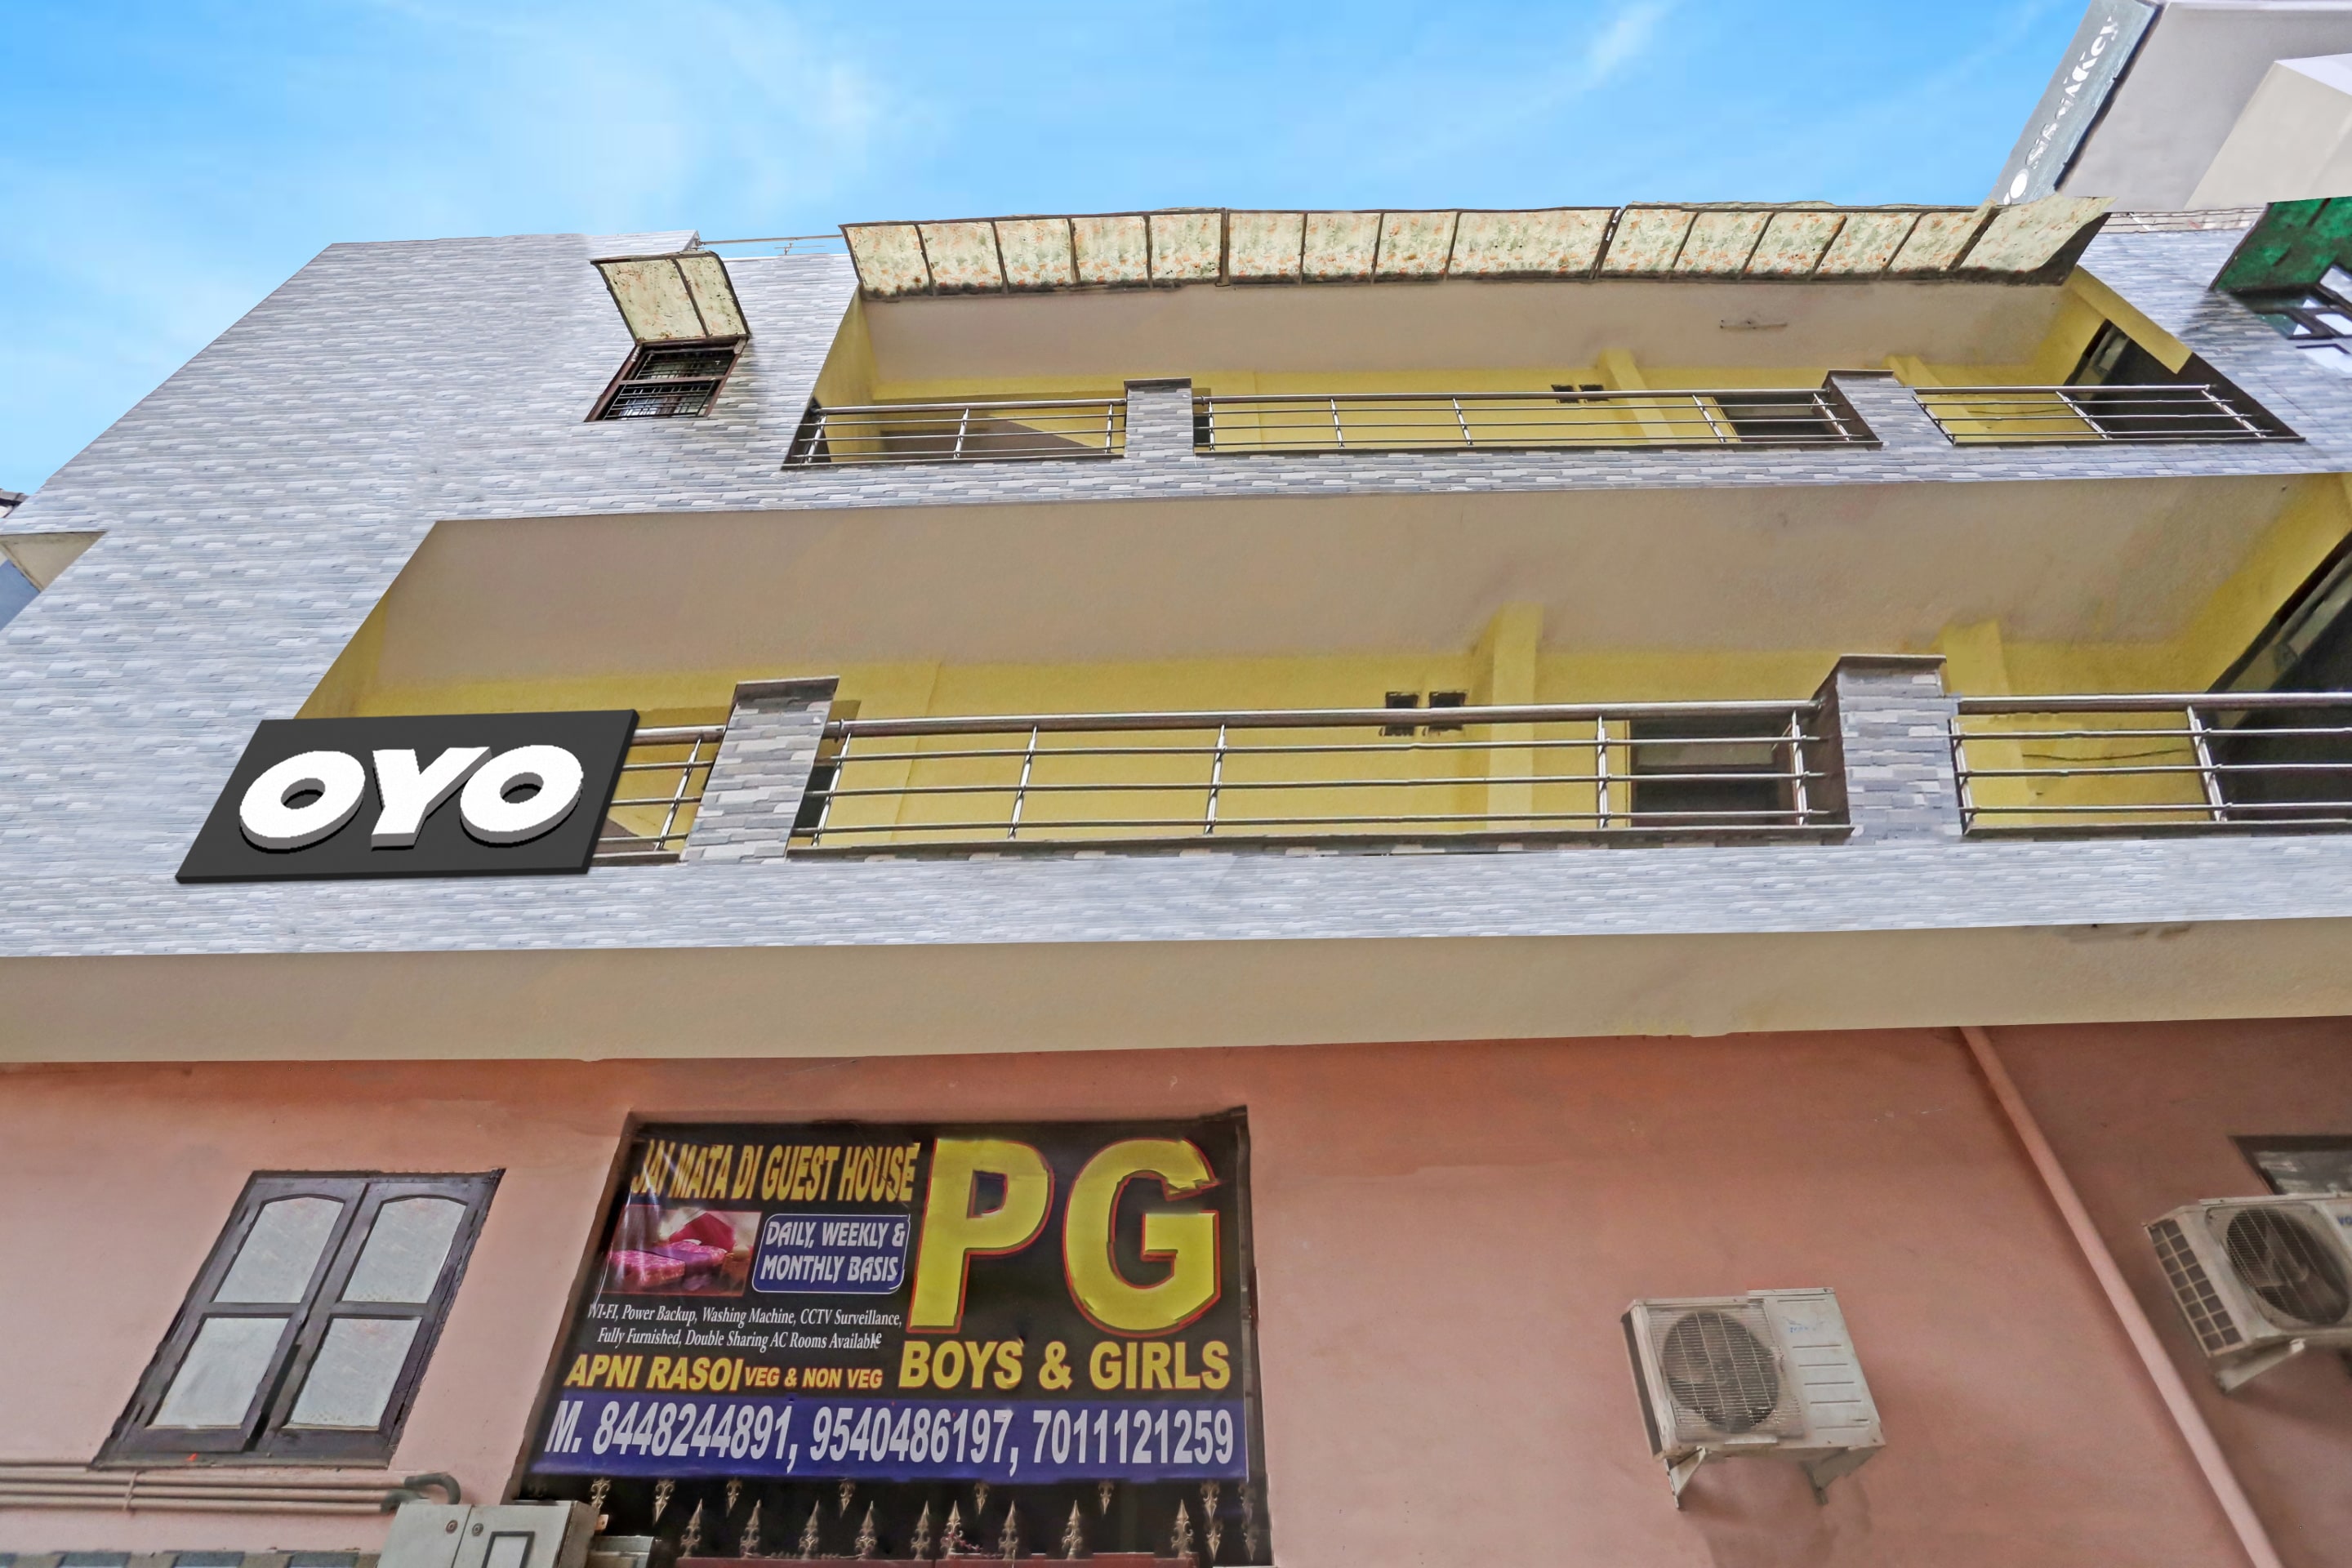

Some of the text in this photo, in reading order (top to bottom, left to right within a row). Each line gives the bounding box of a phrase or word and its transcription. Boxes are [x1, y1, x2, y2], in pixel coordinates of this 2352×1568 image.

[239, 744, 583, 853] OYO
[630, 1139, 921, 1202] JAI MATA DI GUEST HOUSE
[765, 1221, 906, 1250] DAILY, WEEKLY &
[906, 1138, 1222, 1338] PG
[760, 1255, 898, 1284] MONTHLY BASIS
[587, 1303, 902, 1329] WI-FI, Power Backup, Washing Machine, CCTV Surveillance,
[597, 1327, 882, 1353] Fully Furnished, Double Sharing AC Rooms Available
[564, 1353, 884, 1392] APNI RASOI VEG & NON VEG
[898, 1339, 1231, 1390] BOYS & GIRLS
[544, 1401, 1234, 1477] M. 8448244891, 9540486197, 7011121259
